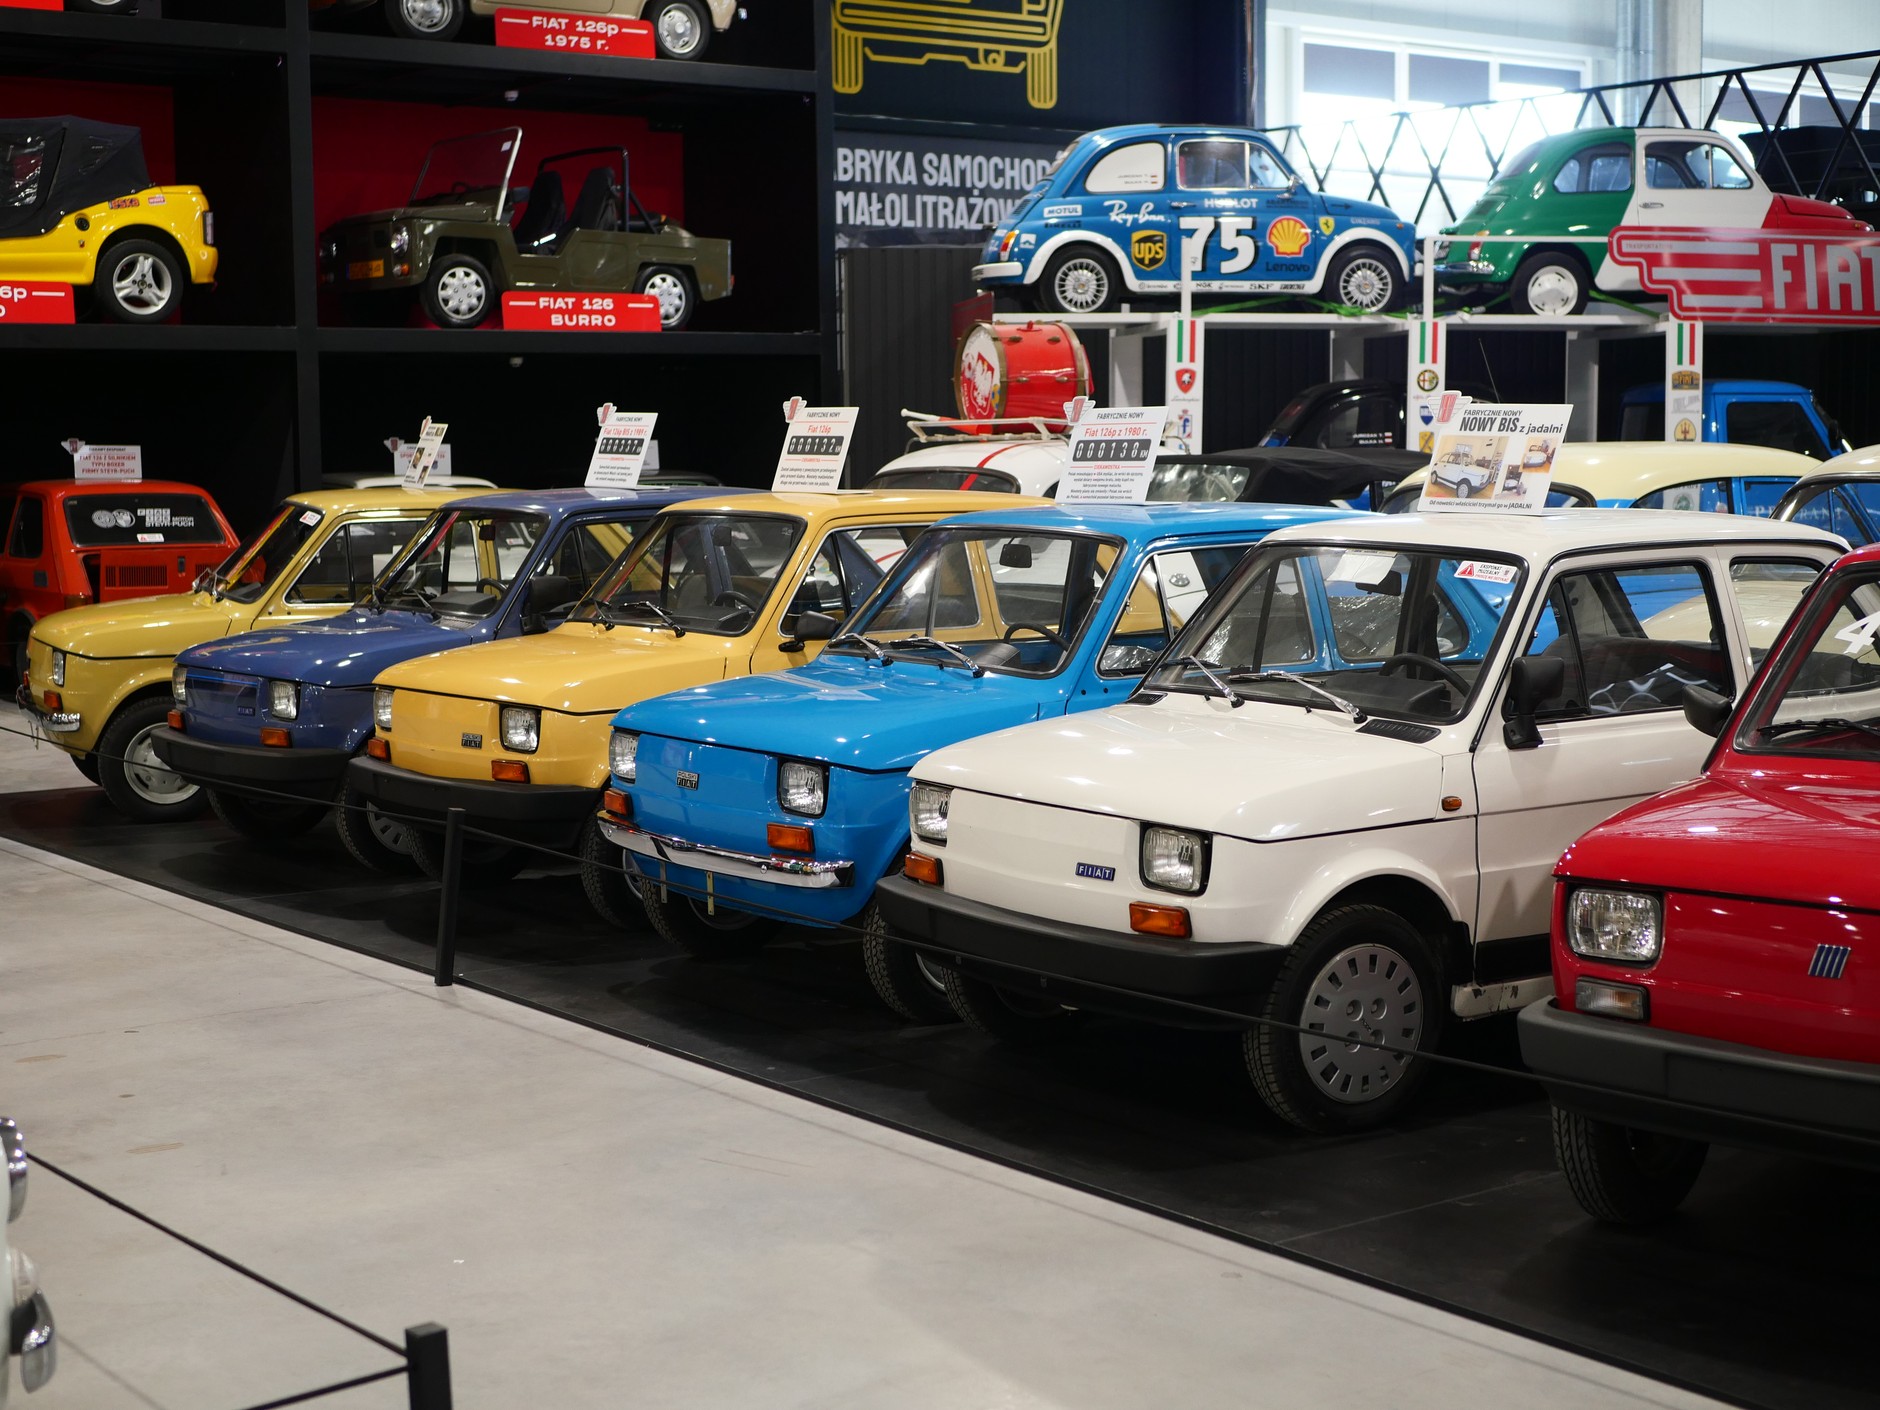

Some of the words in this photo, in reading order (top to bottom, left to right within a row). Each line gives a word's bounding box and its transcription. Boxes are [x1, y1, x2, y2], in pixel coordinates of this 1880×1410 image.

[532, 16, 569, 30] FIAT
[575, 20, 619, 37] 126p
[545, 34, 591, 49] 1975
[834, 148, 918, 185] BRYKA
[1047, 206, 1079, 215] MOTUL
[1103, 200, 1167, 227] Ray-Ban
[1179, 216, 1257, 274] 75
[1135, 242, 1163, 264] ups
[1265, 261, 1310, 272] Lenovo
[1770, 243, 1880, 311] FIAT
[539, 297, 576, 310] FIAT
[582, 298, 614, 310] 126
[551, 314, 616, 326] BURRO
[1084, 428, 1099, 437] Fiat
[1100, 428, 1116, 438] 126p
[1124, 427, 1142, 436] 1980
[1459, 417, 1497, 432] NOWY
[1498, 417, 1520, 432] BIS
[1519, 425, 1525, 433] z
[1525, 423, 1564, 435] jadalni
[677, 778, 696, 789] FIAT
[1077, 865, 1112, 879] FIAT
